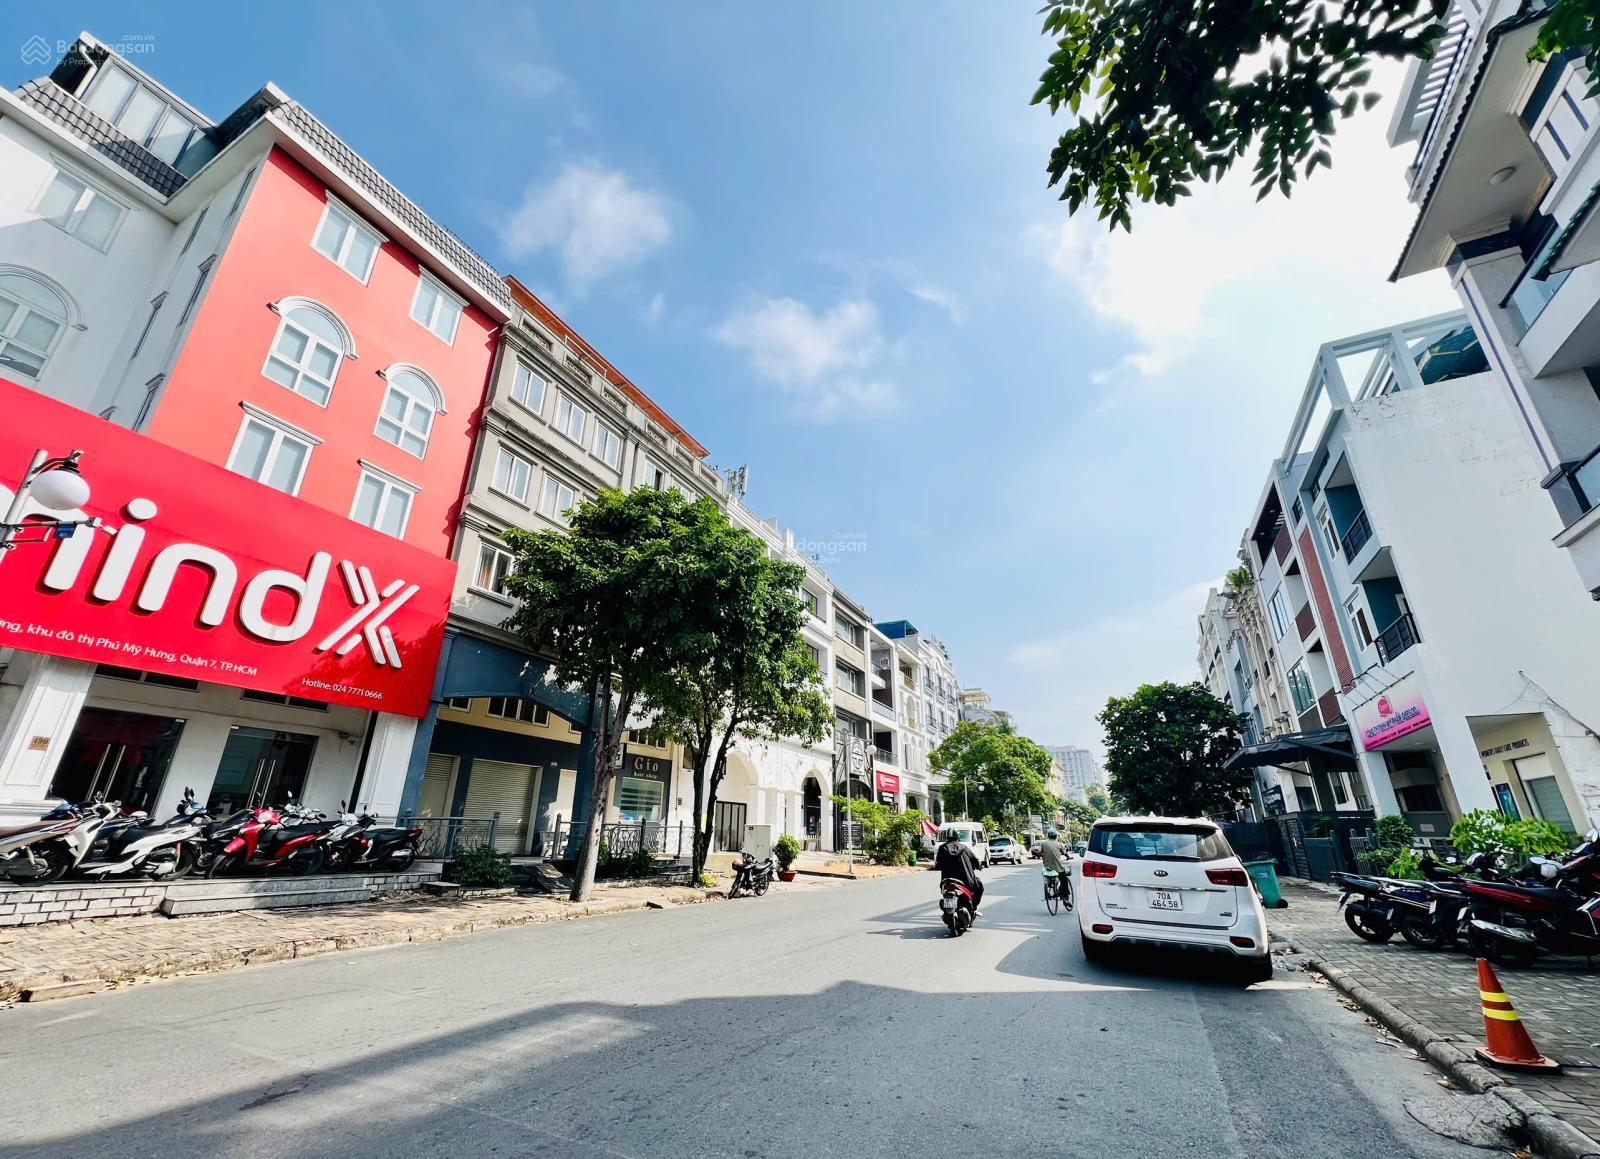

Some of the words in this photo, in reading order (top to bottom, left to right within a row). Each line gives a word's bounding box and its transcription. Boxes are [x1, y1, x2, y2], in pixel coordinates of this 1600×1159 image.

[27, 623, 53, 637] khu
[77, 634, 95, 646] thị
[96, 637, 120, 650] Phú
[122, 642, 142, 656] Mỹ
[144, 646, 177, 662] Hưng,
[180, 653, 207, 667] Quận
[209, 660, 217, 669] 7,
[301, 677, 332, 690] Hotline:
[332, 683, 347, 693] 024
[634, 756, 658, 772] Gio
[1156, 892, 1171, 900] 70A
